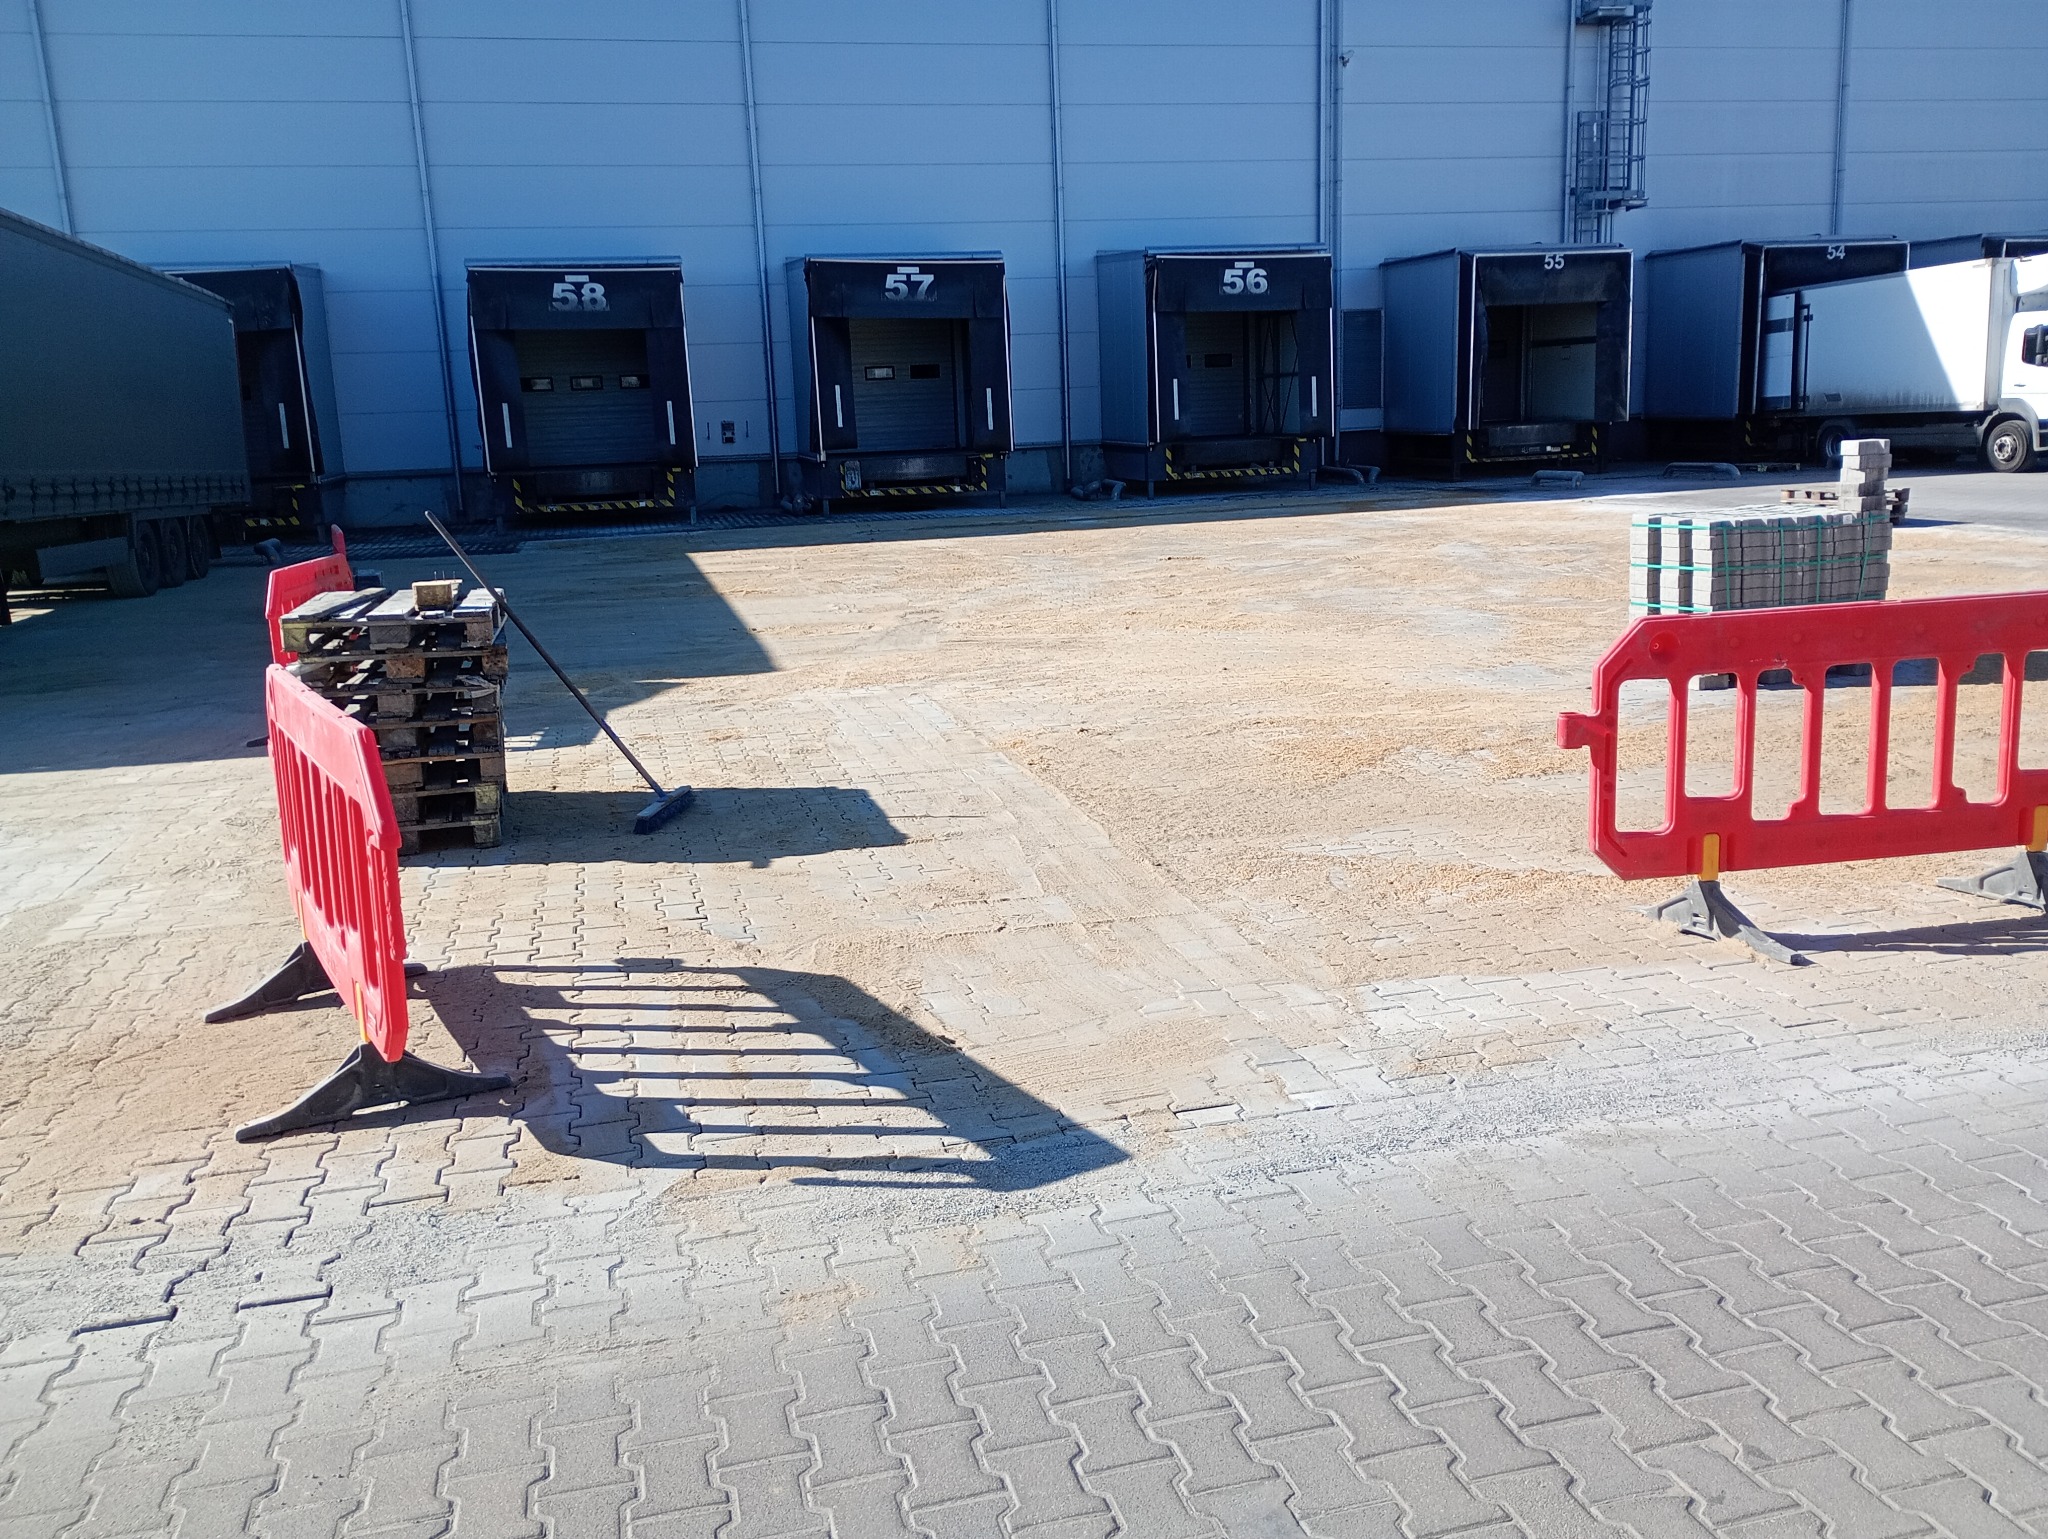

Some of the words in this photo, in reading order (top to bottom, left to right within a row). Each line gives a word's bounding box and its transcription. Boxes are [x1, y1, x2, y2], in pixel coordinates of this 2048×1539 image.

[1544, 253, 1565, 270] 55
[1827, 244, 1846, 260] 54
[885, 274, 934, 301] 57
[1223, 268, 1268, 294] 56
[552, 283, 607, 311] 58
